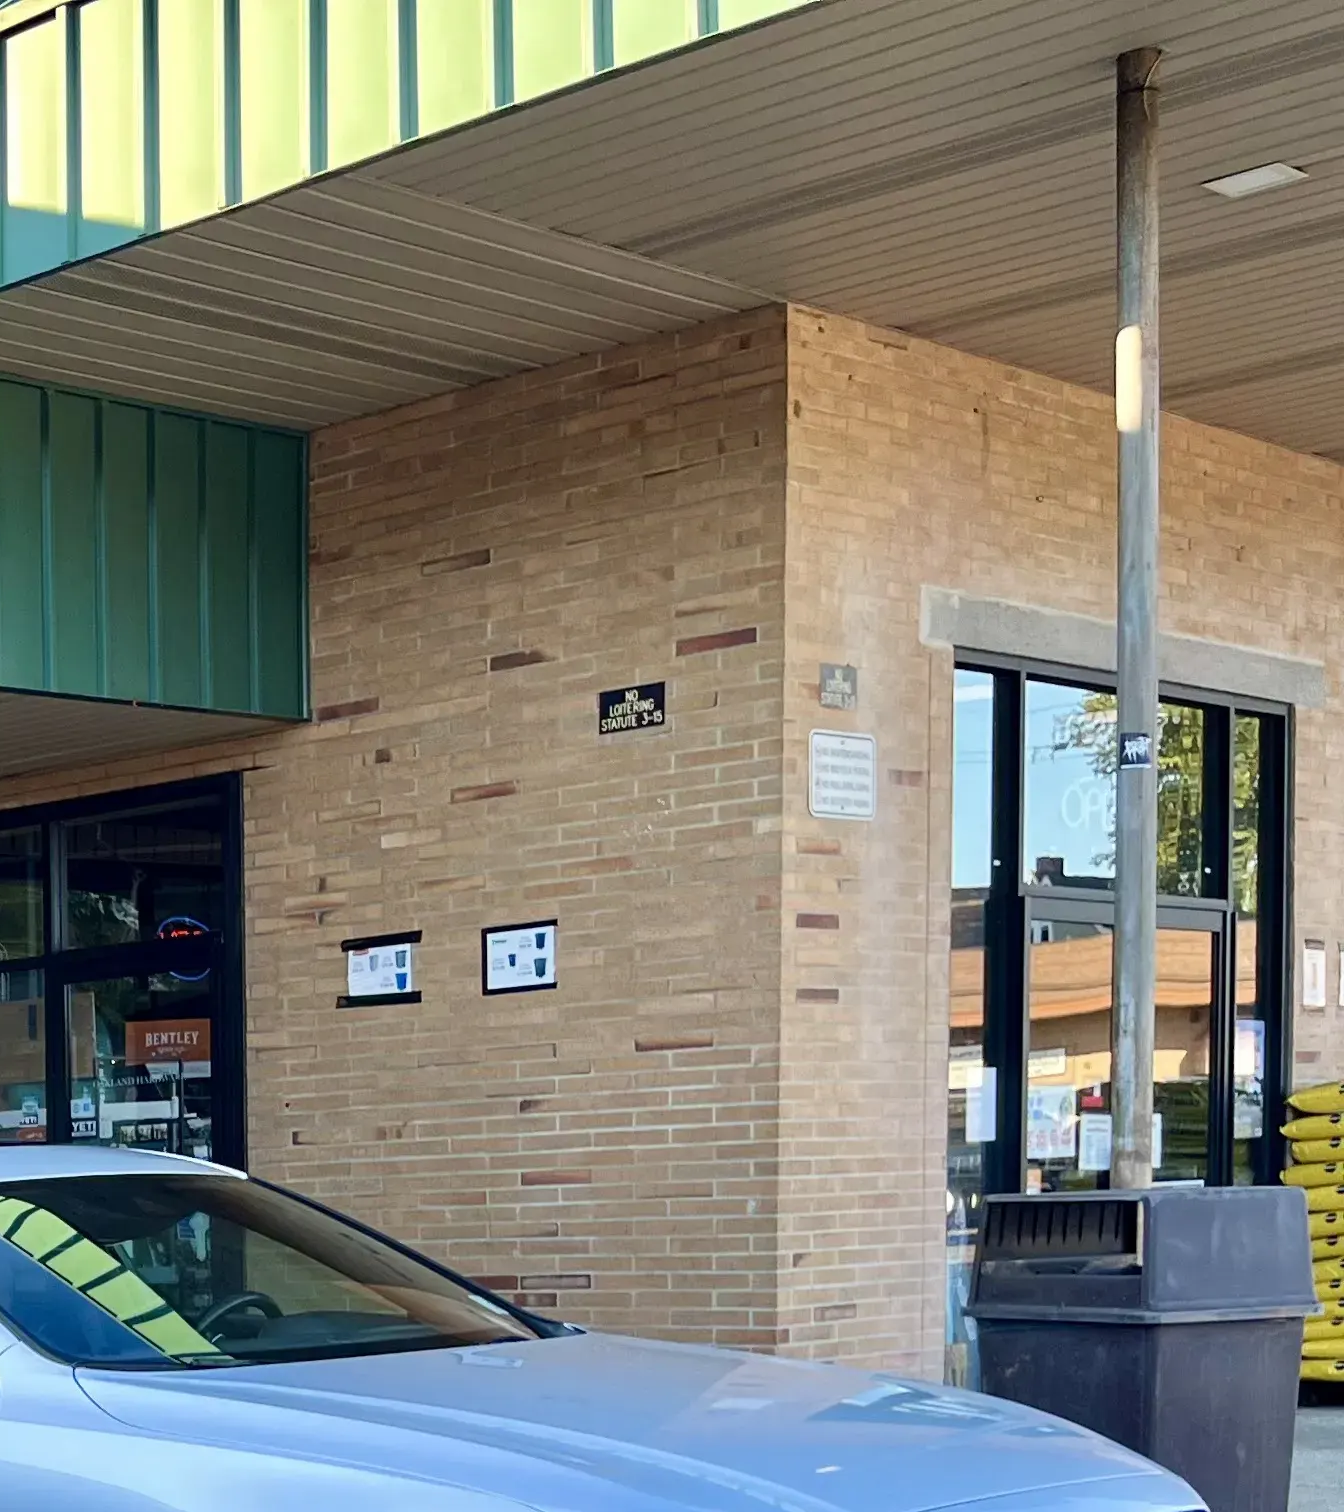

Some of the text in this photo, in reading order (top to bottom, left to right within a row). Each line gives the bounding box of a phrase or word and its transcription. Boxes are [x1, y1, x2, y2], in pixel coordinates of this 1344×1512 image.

[624, 689, 639, 703] NO
[609, 698, 655, 717] LOITERING
[601, 714, 638, 732] STATUTE
[144, 1030, 200, 1048] BENTLEY
[71, 1120, 96, 1133] YETI
